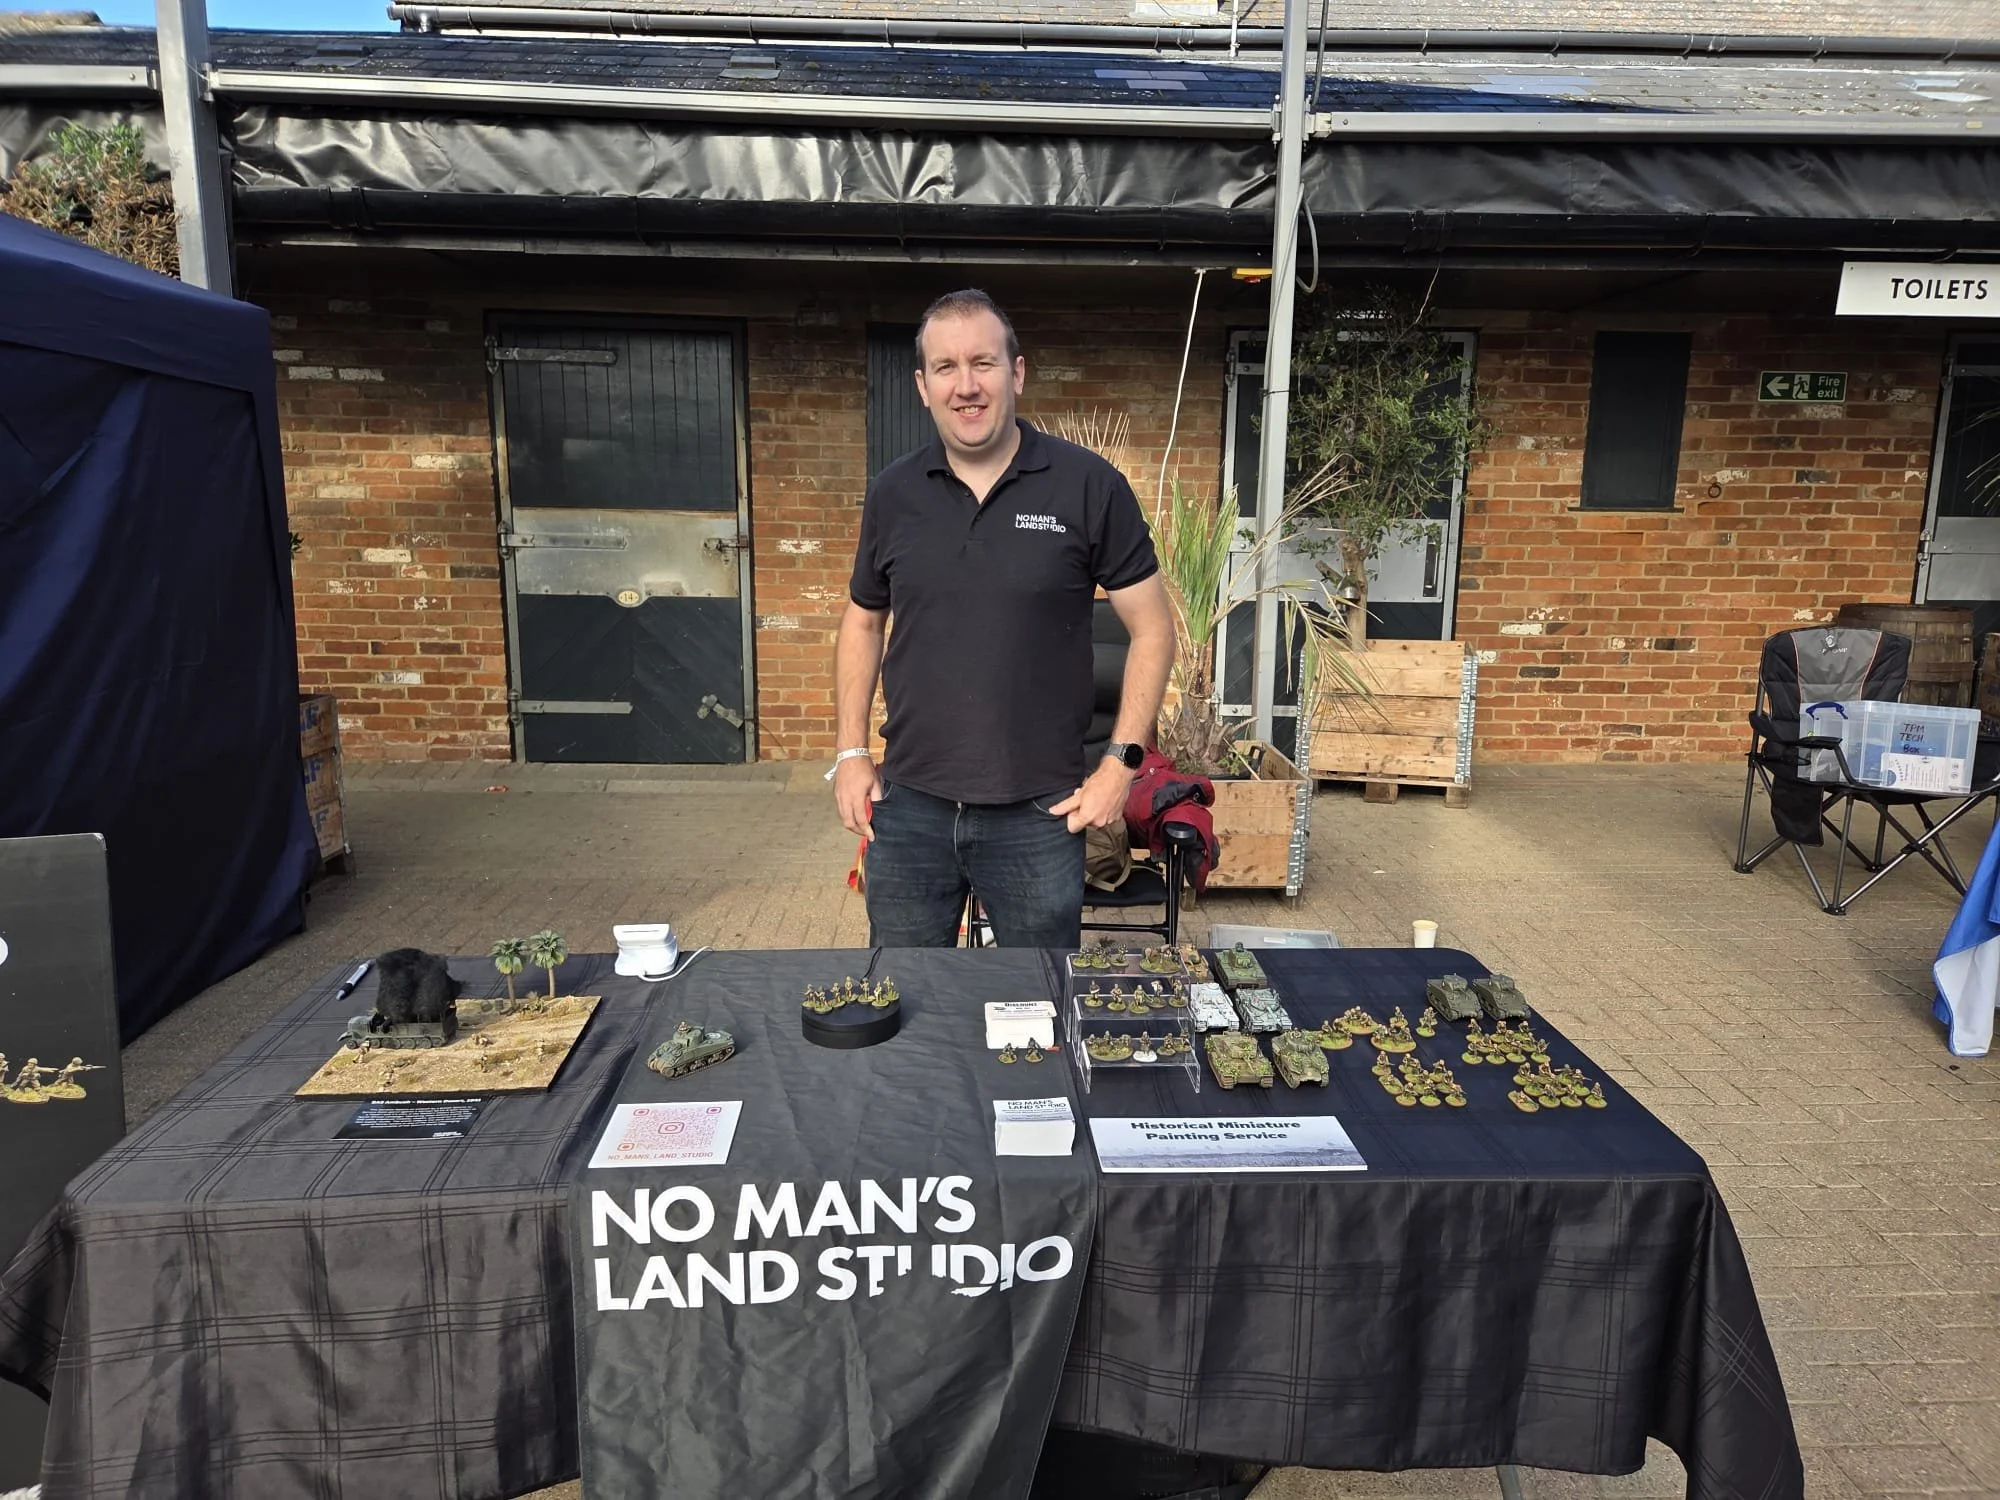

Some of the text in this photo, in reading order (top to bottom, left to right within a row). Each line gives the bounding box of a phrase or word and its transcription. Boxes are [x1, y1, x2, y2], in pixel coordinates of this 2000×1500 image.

[1891, 278, 1988, 300] TOILETS
[1818, 375, 1841, 387] Fire
[1817, 387, 1839, 398] exit
[1016, 513, 1057, 524] NO MAN'S
[1015, 520, 1038, 530] LAND
[624, 592, 634, 602] 14
[1904, 723, 1925, 733] TPM
[1900, 733, 1925, 742] TECH
[1218, 1121, 1301, 1129] Miniature
[1146, 1132, 1288, 1141] Painting Service
[591, 1175, 976, 1247] NO MAN'S
[595, 1249, 799, 1311] LAND
